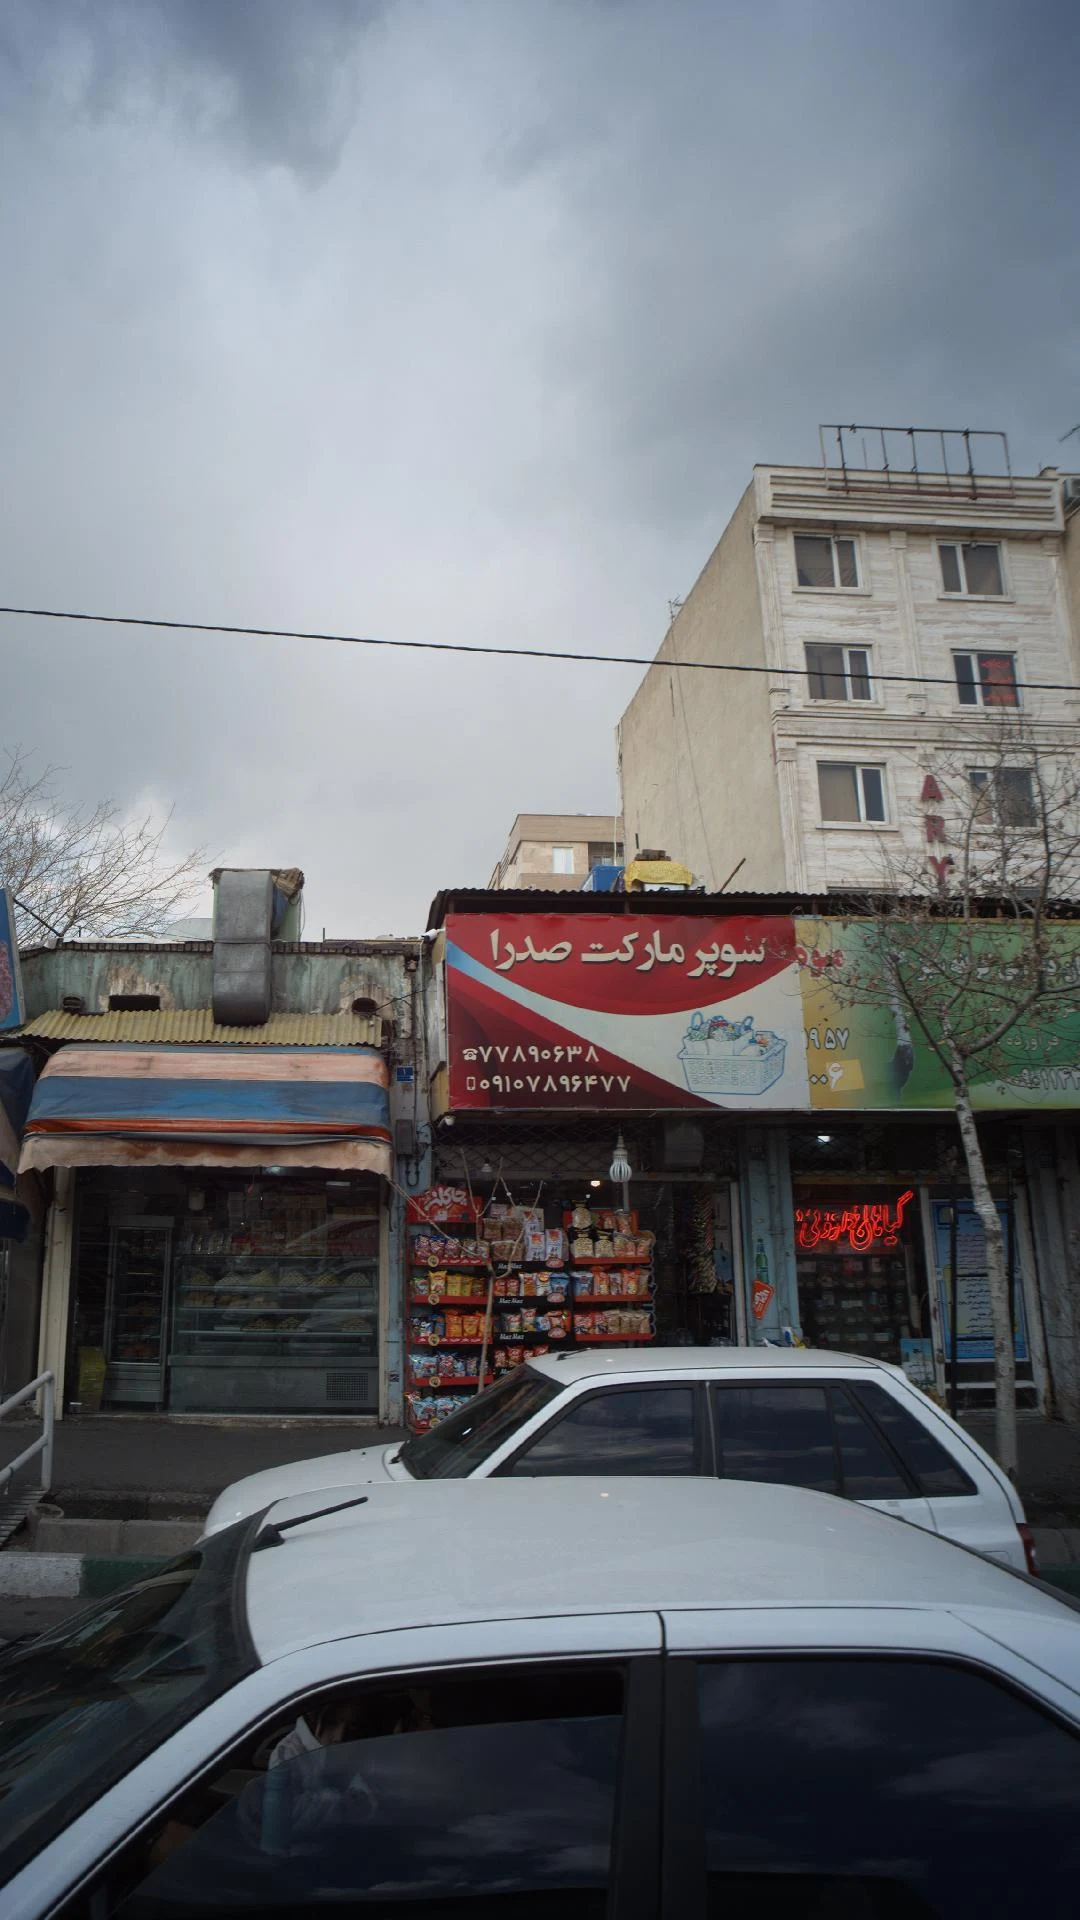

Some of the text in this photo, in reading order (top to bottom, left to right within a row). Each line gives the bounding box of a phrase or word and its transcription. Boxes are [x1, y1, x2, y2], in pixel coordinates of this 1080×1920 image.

[489, 928, 573, 970] صدرا
[581, 929, 686, 971] مارکت
[687, 940, 766, 977] سوپر
[480, 1045, 600, 1063] ۷۷۸۹۰۶۳۸
[480, 1075, 631, 1093] ۰۹۱۰۷۸۹۶۴۷۷
